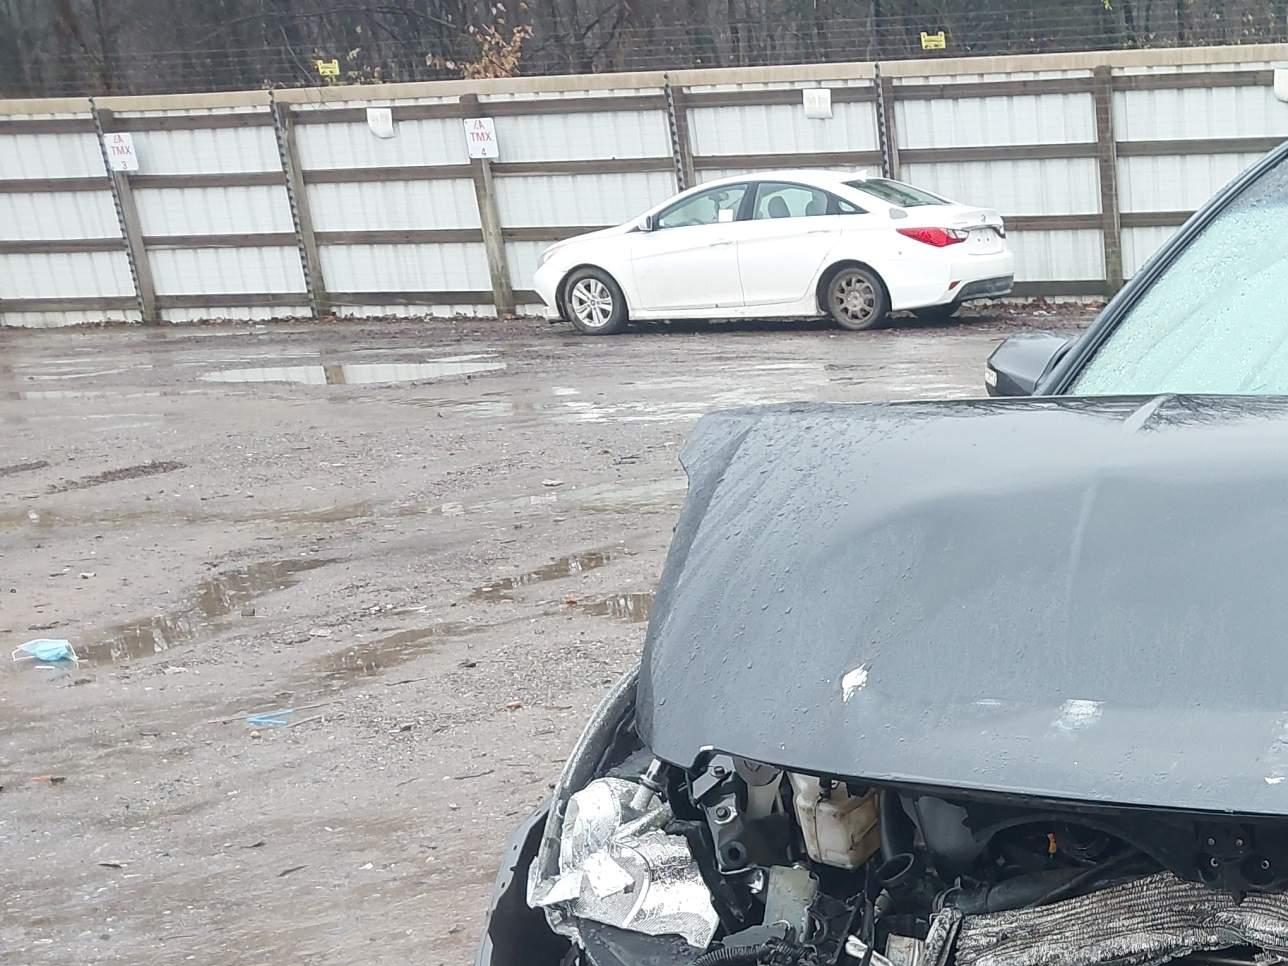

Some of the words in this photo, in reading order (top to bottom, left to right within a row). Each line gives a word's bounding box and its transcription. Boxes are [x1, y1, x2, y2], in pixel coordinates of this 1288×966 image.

[470, 131, 492, 142] TMX
[110, 146, 131, 156] TMX
[121, 161, 128, 170] 3
